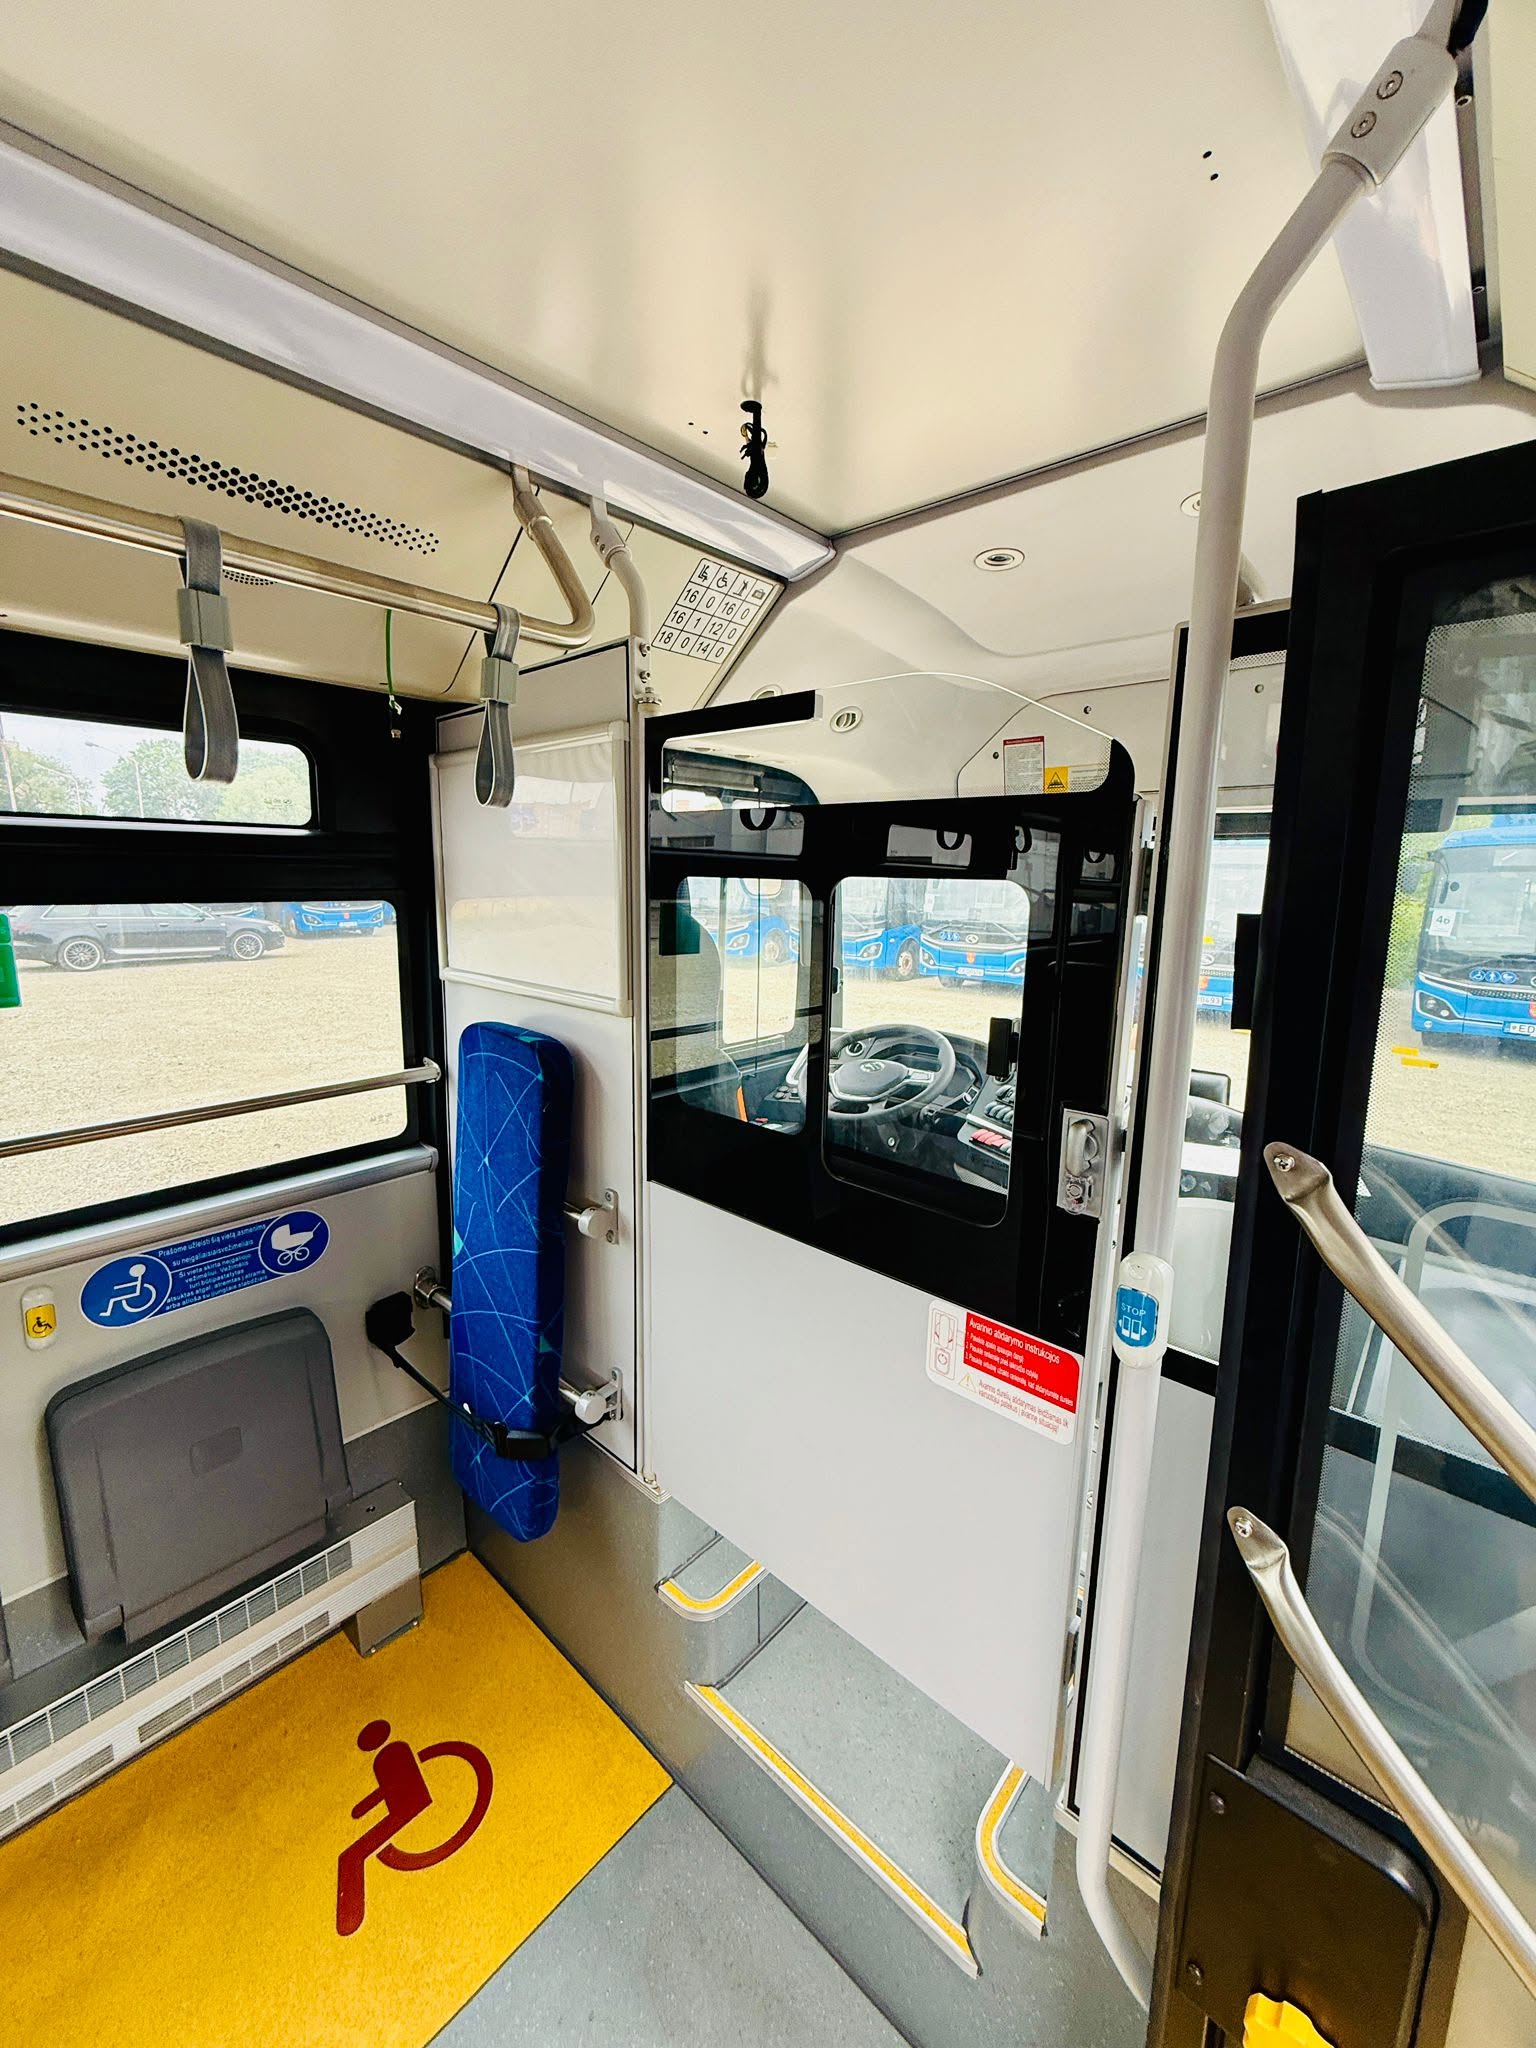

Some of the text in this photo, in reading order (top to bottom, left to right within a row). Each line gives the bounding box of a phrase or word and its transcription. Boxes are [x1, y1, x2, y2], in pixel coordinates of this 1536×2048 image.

[682, 588, 750, 620] 16 0 16 0
[670, 610, 737, 640] 16 1 12 0
[658, 631, 724, 658] 18 0 14 0
[158, 1246, 187, 1257] Prašome
[237, 1224, 266, 1237] asmenims
[1121, 1302, 1146, 1316] STOP
[969, 1318, 993, 1336] Avarinio
[993, 1329, 1024, 1348] atidarymo
